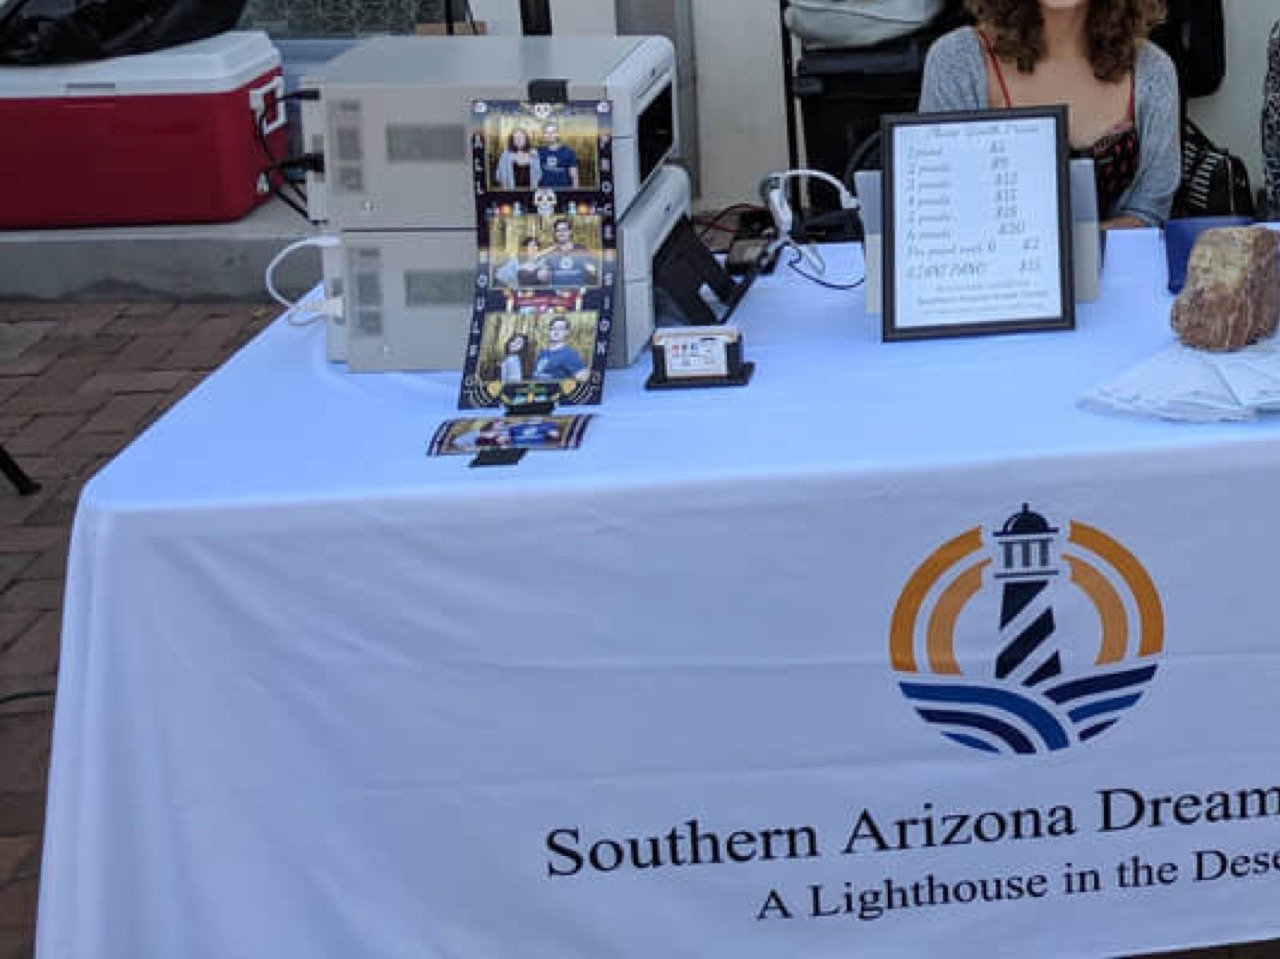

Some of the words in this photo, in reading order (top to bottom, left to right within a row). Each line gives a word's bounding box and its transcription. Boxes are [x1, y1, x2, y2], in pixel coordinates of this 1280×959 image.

[474, 134, 485, 195] ALL
[546, 818, 821, 878] Southern
[840, 802, 1078, 855] Arizona
[755, 888, 794, 922] A
[808, 872, 1049, 923] Lighthouse
[1062, 861, 1102, 895] in
[1115, 853, 1179, 889] the
